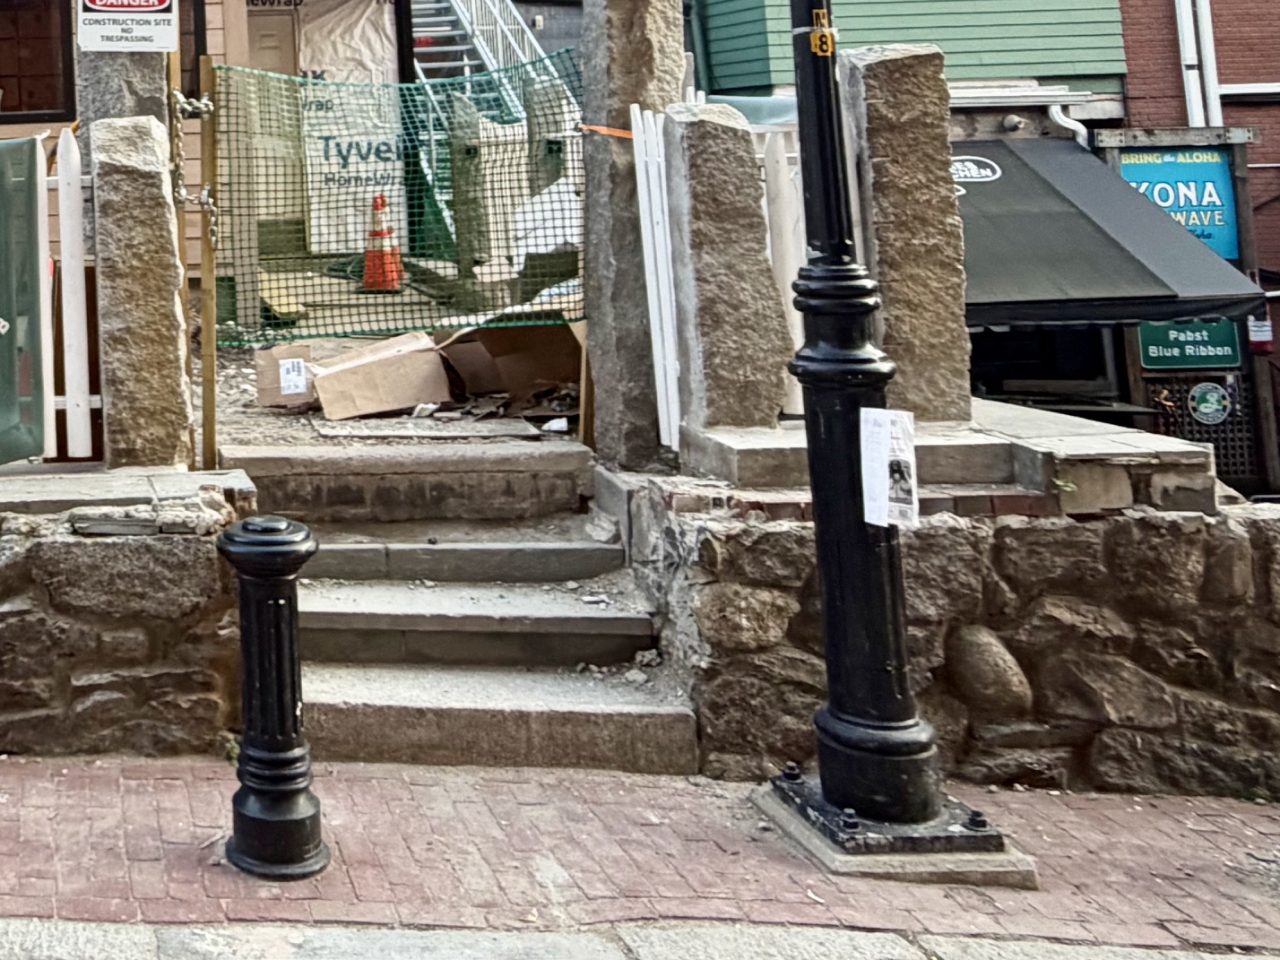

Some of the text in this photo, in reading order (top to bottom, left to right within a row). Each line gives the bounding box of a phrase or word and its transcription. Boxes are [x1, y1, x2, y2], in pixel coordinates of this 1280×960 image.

[82, 18, 173, 27] CONSTRUCTION SITE
[120, 27, 134, 35] NO
[100, 35, 155, 43] TRESPASSING
[1120, 152, 1163, 164] BRING
[1176, 151, 1223, 163] ALOHA
[1169, 210, 1225, 226] WAVE
[1168, 330, 1209, 341] Pabst
[1148, 344, 1233, 356] Blue Ribbon
